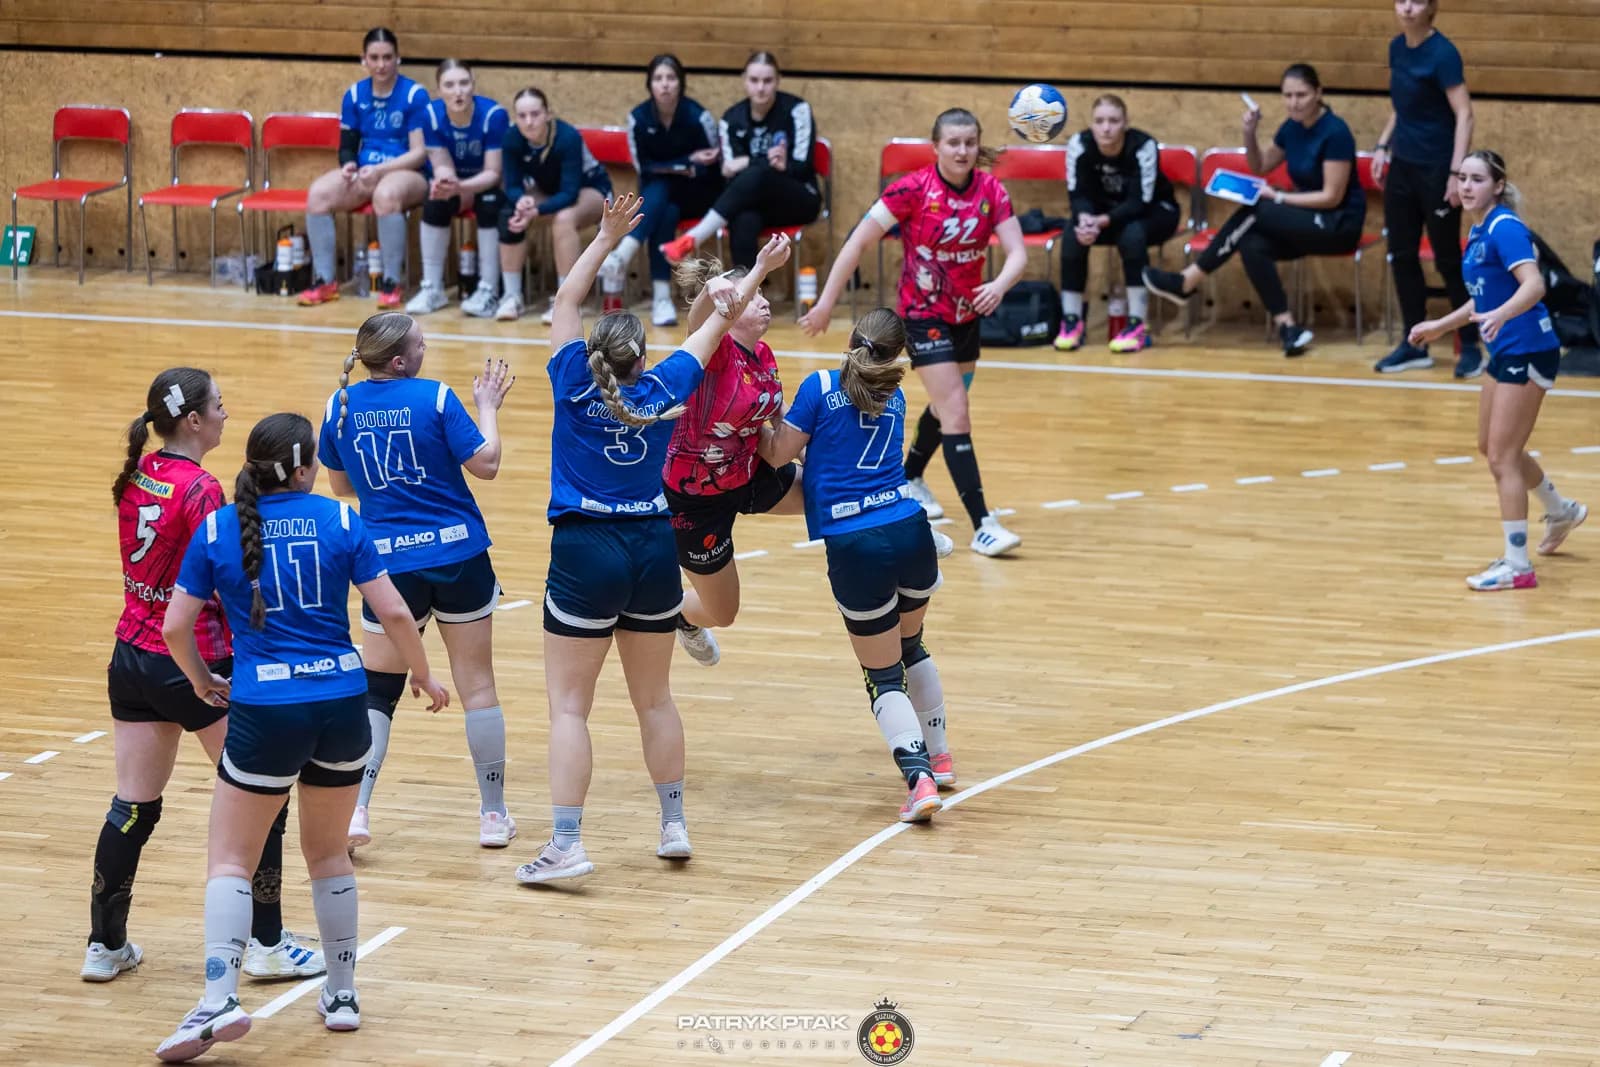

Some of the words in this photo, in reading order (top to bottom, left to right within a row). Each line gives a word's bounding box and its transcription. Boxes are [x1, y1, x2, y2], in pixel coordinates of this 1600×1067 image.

[939, 217, 979, 244] 32
[354, 406, 411, 429] BORYŃ
[751, 391, 783, 421] 22
[603, 424, 648, 466] 3
[856, 411, 896, 470] 7
[353, 430, 426, 490] 14
[615, 501, 654, 513] AL-KO
[863, 490, 896, 508] AL-KO
[129, 503, 162, 564] 5
[394, 531, 436, 548] AL-KO
[688, 551, 710, 562] Targi
[262, 541, 322, 612] 11
[293, 657, 336, 674] AL-KO
